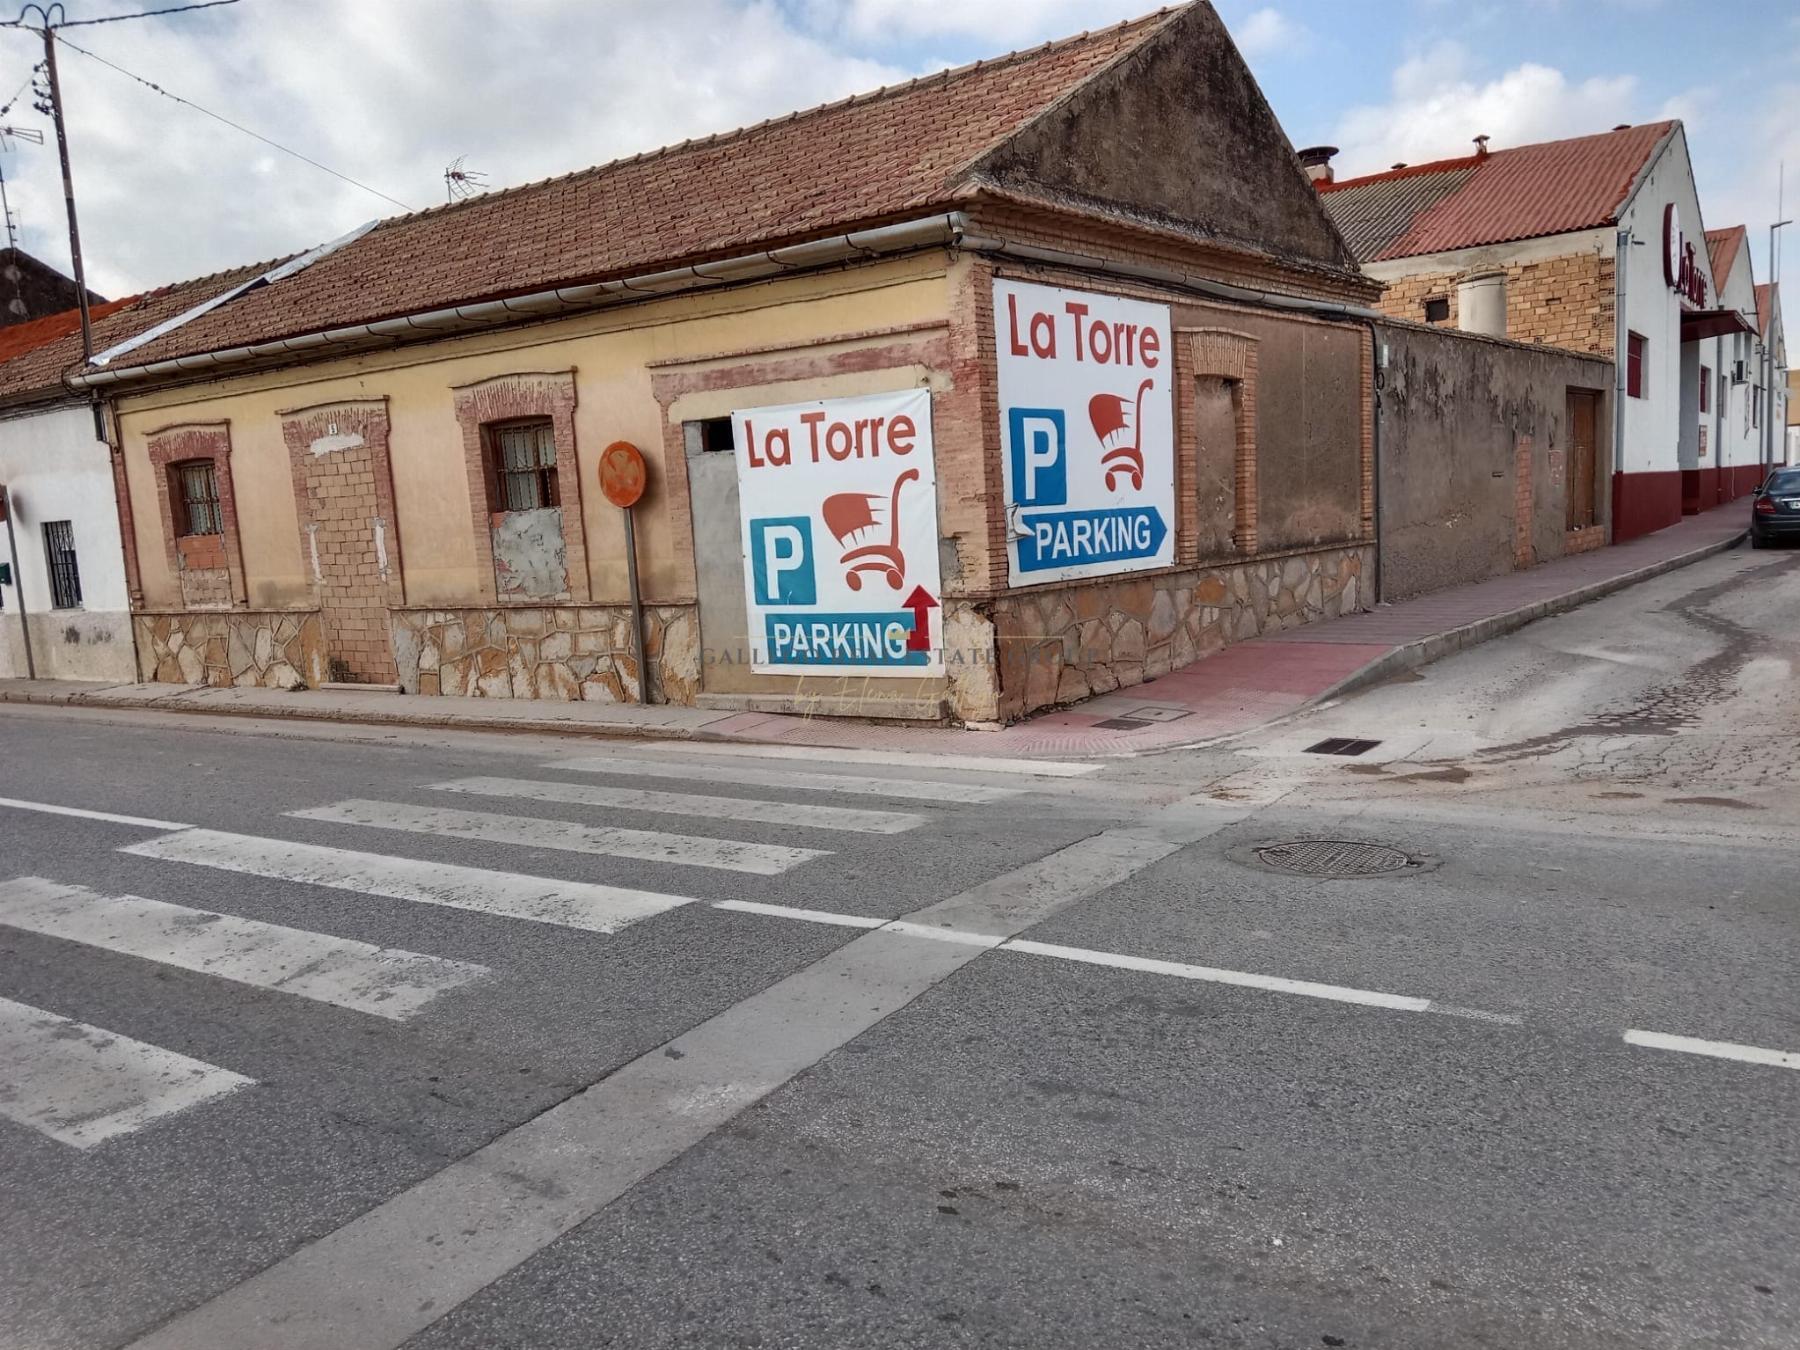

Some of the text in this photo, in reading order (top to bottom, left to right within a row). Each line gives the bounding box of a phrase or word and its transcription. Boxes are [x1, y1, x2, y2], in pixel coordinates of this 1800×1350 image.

[1008, 293, 1160, 368] La Torre
[744, 411, 916, 468] La Torre
[1022, 417, 1058, 500] P
[763, 525, 804, 600] P
[1034, 513, 1151, 560] PARKING
[774, 622, 907, 660] PARKING
